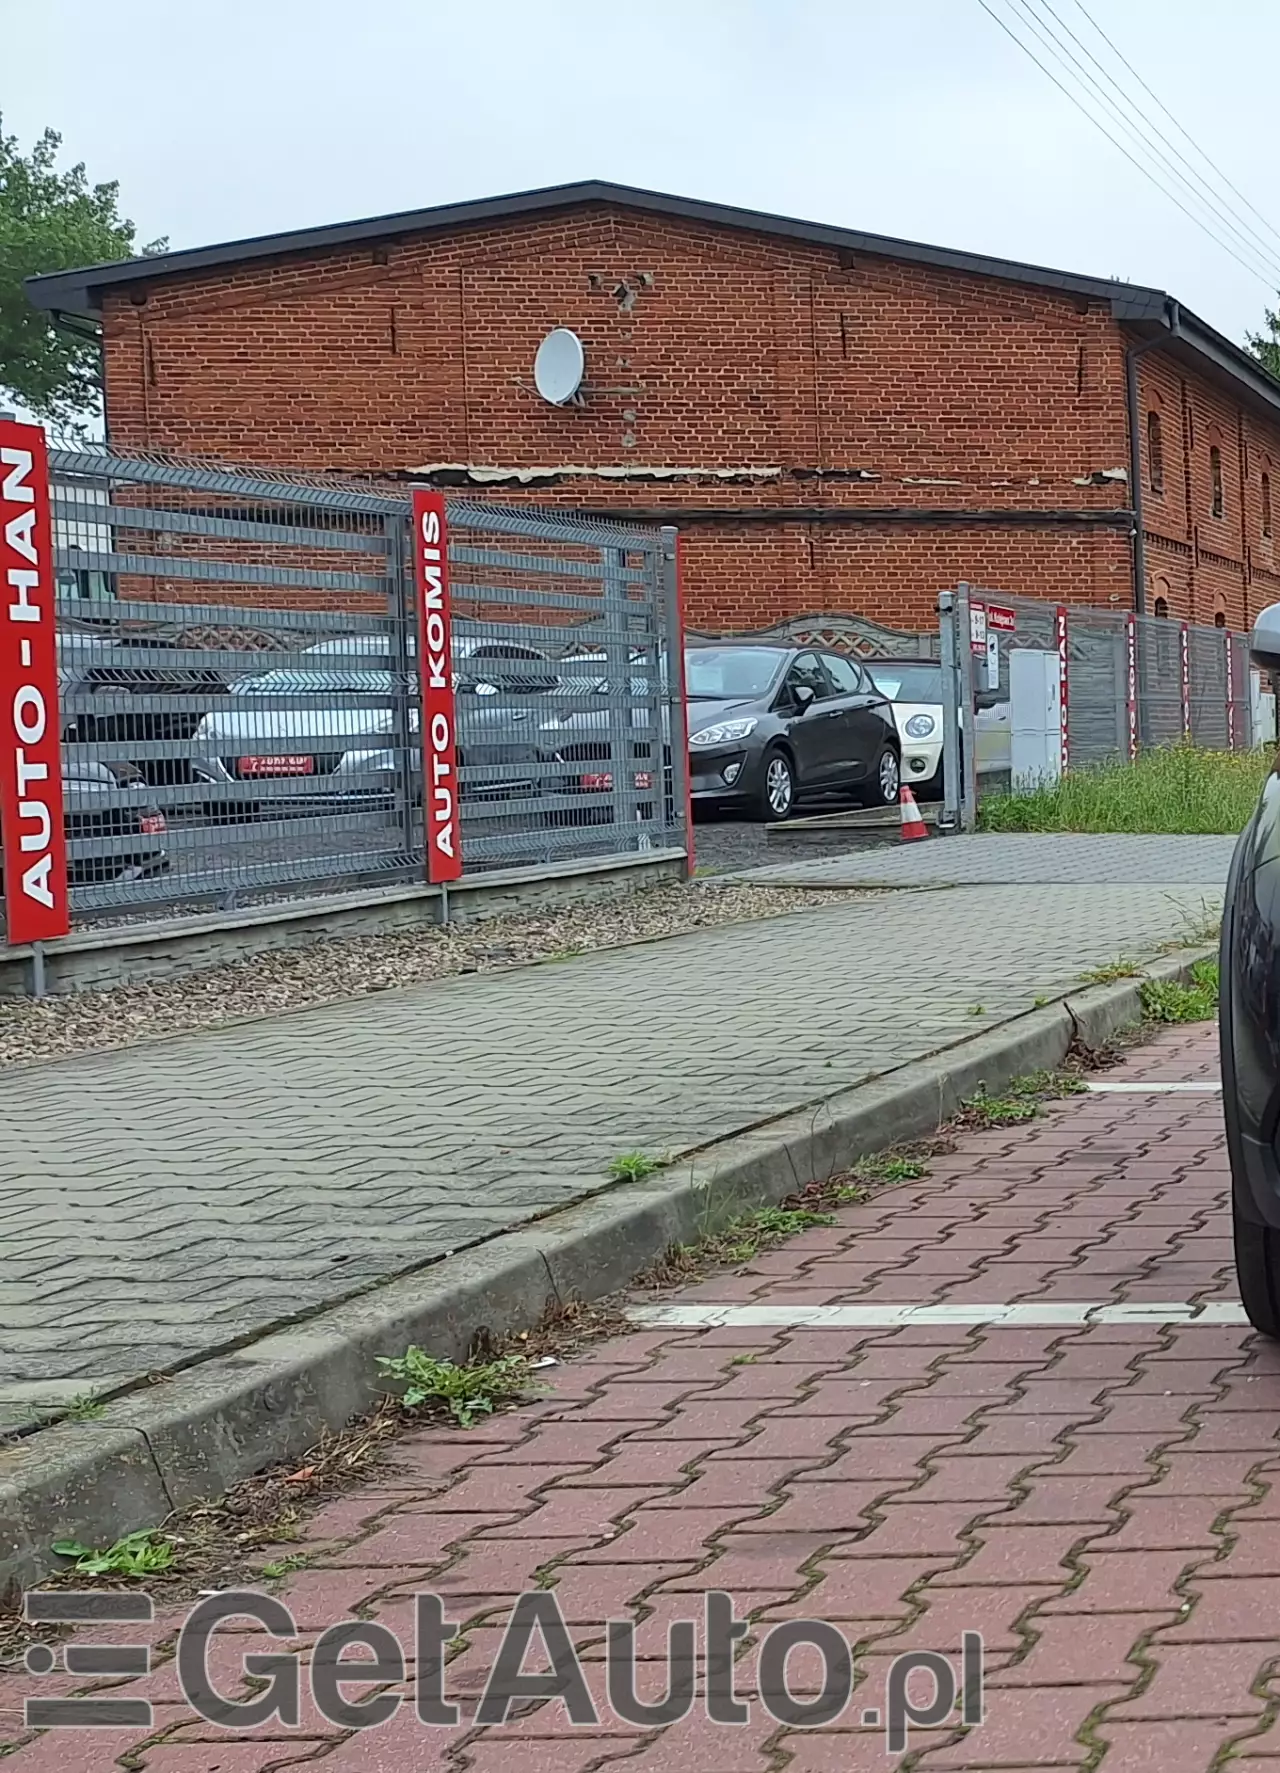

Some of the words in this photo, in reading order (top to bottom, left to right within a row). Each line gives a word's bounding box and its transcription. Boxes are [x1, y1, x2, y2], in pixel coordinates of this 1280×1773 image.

[0, 446, 42, 623] HAN
[421, 509, 446, 690] KOMIS
[13, 684, 54, 910] AUTO
[431, 712, 454, 858] AUTO
